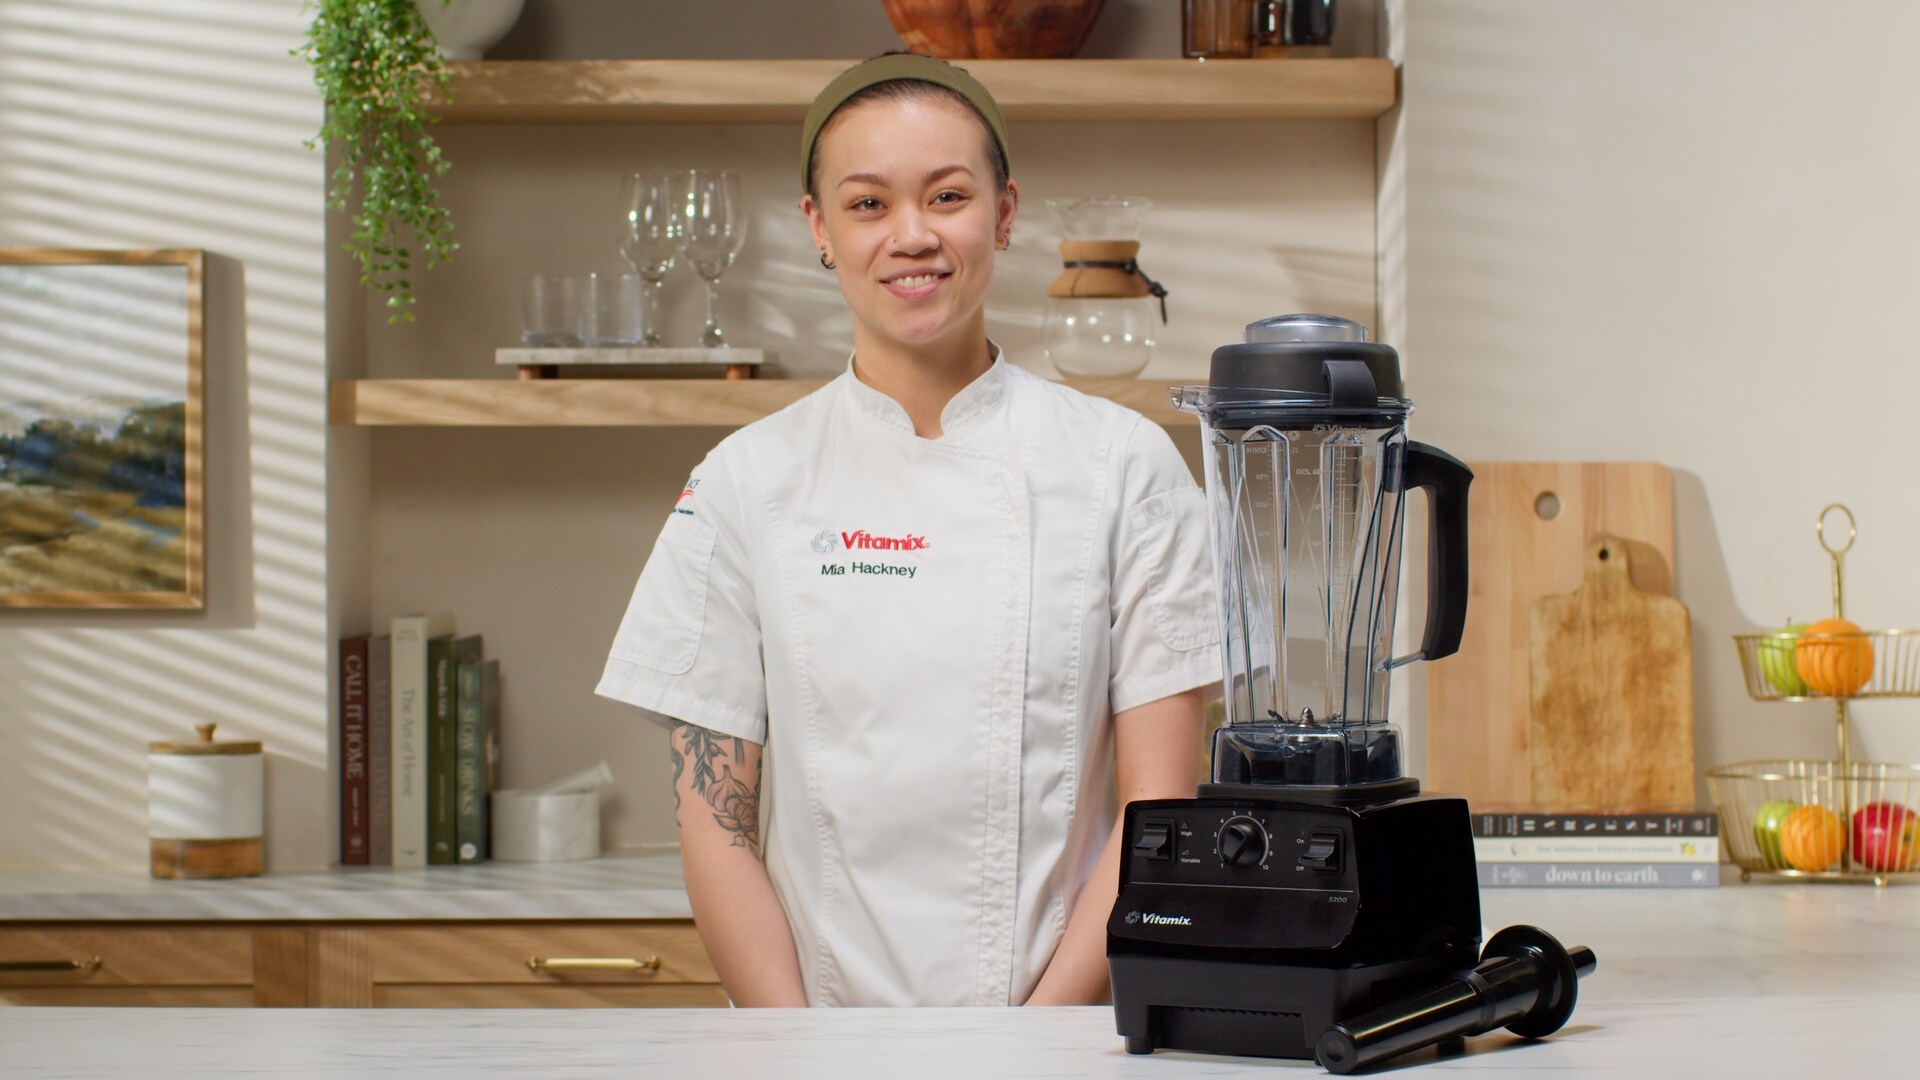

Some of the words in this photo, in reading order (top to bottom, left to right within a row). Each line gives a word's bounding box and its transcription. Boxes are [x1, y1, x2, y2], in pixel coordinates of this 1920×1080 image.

[841, 529, 926, 551] Vitamix
[821, 563, 845, 575] Mia
[852, 561, 917, 579] Hackney
[346, 654, 363, 700] CALL
[346, 703, 363, 720] IT
[402, 688, 416, 715] The
[402, 717, 415, 738] Art
[346, 724, 363, 780] HOME
[402, 755, 415, 798] Home
[1545, 866, 1592, 883] down
[1595, 867, 1606, 883] to
[1615, 866, 1658, 883] earth
[1142, 913, 1191, 925] Vitamix
